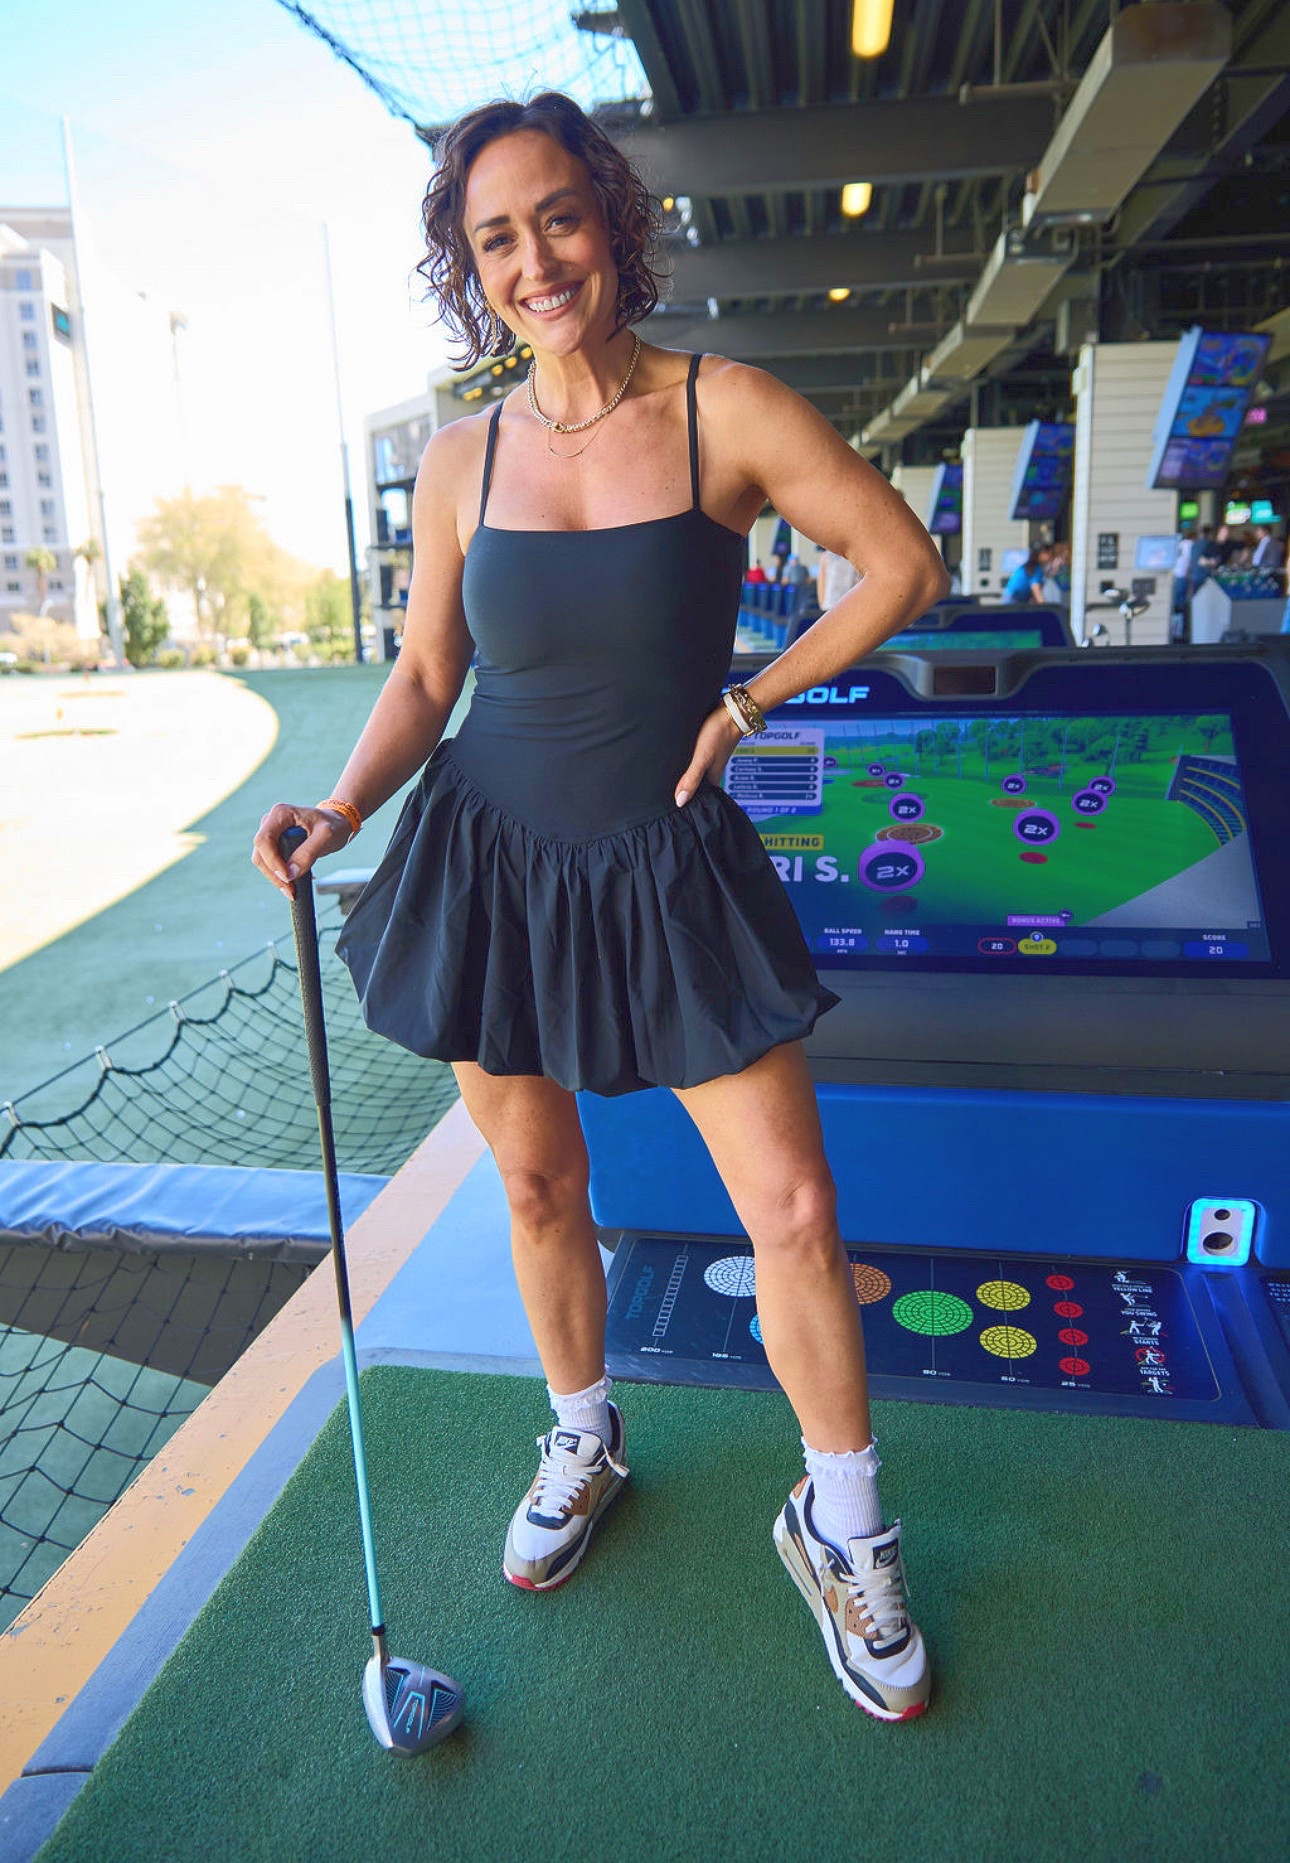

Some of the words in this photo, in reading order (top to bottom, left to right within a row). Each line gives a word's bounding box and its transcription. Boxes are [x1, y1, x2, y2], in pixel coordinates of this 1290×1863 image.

[764, 836, 820, 847] HITTING
[770, 855, 803, 882] RI
[815, 855, 849, 882] S.
[824, 927, 841, 935] BALL
[895, 939, 909, 948] 1.0
[991, 942, 1004, 950] 20
[1208, 946, 1223, 954] 20
[625, 1264, 655, 1319] TOPGOLF
